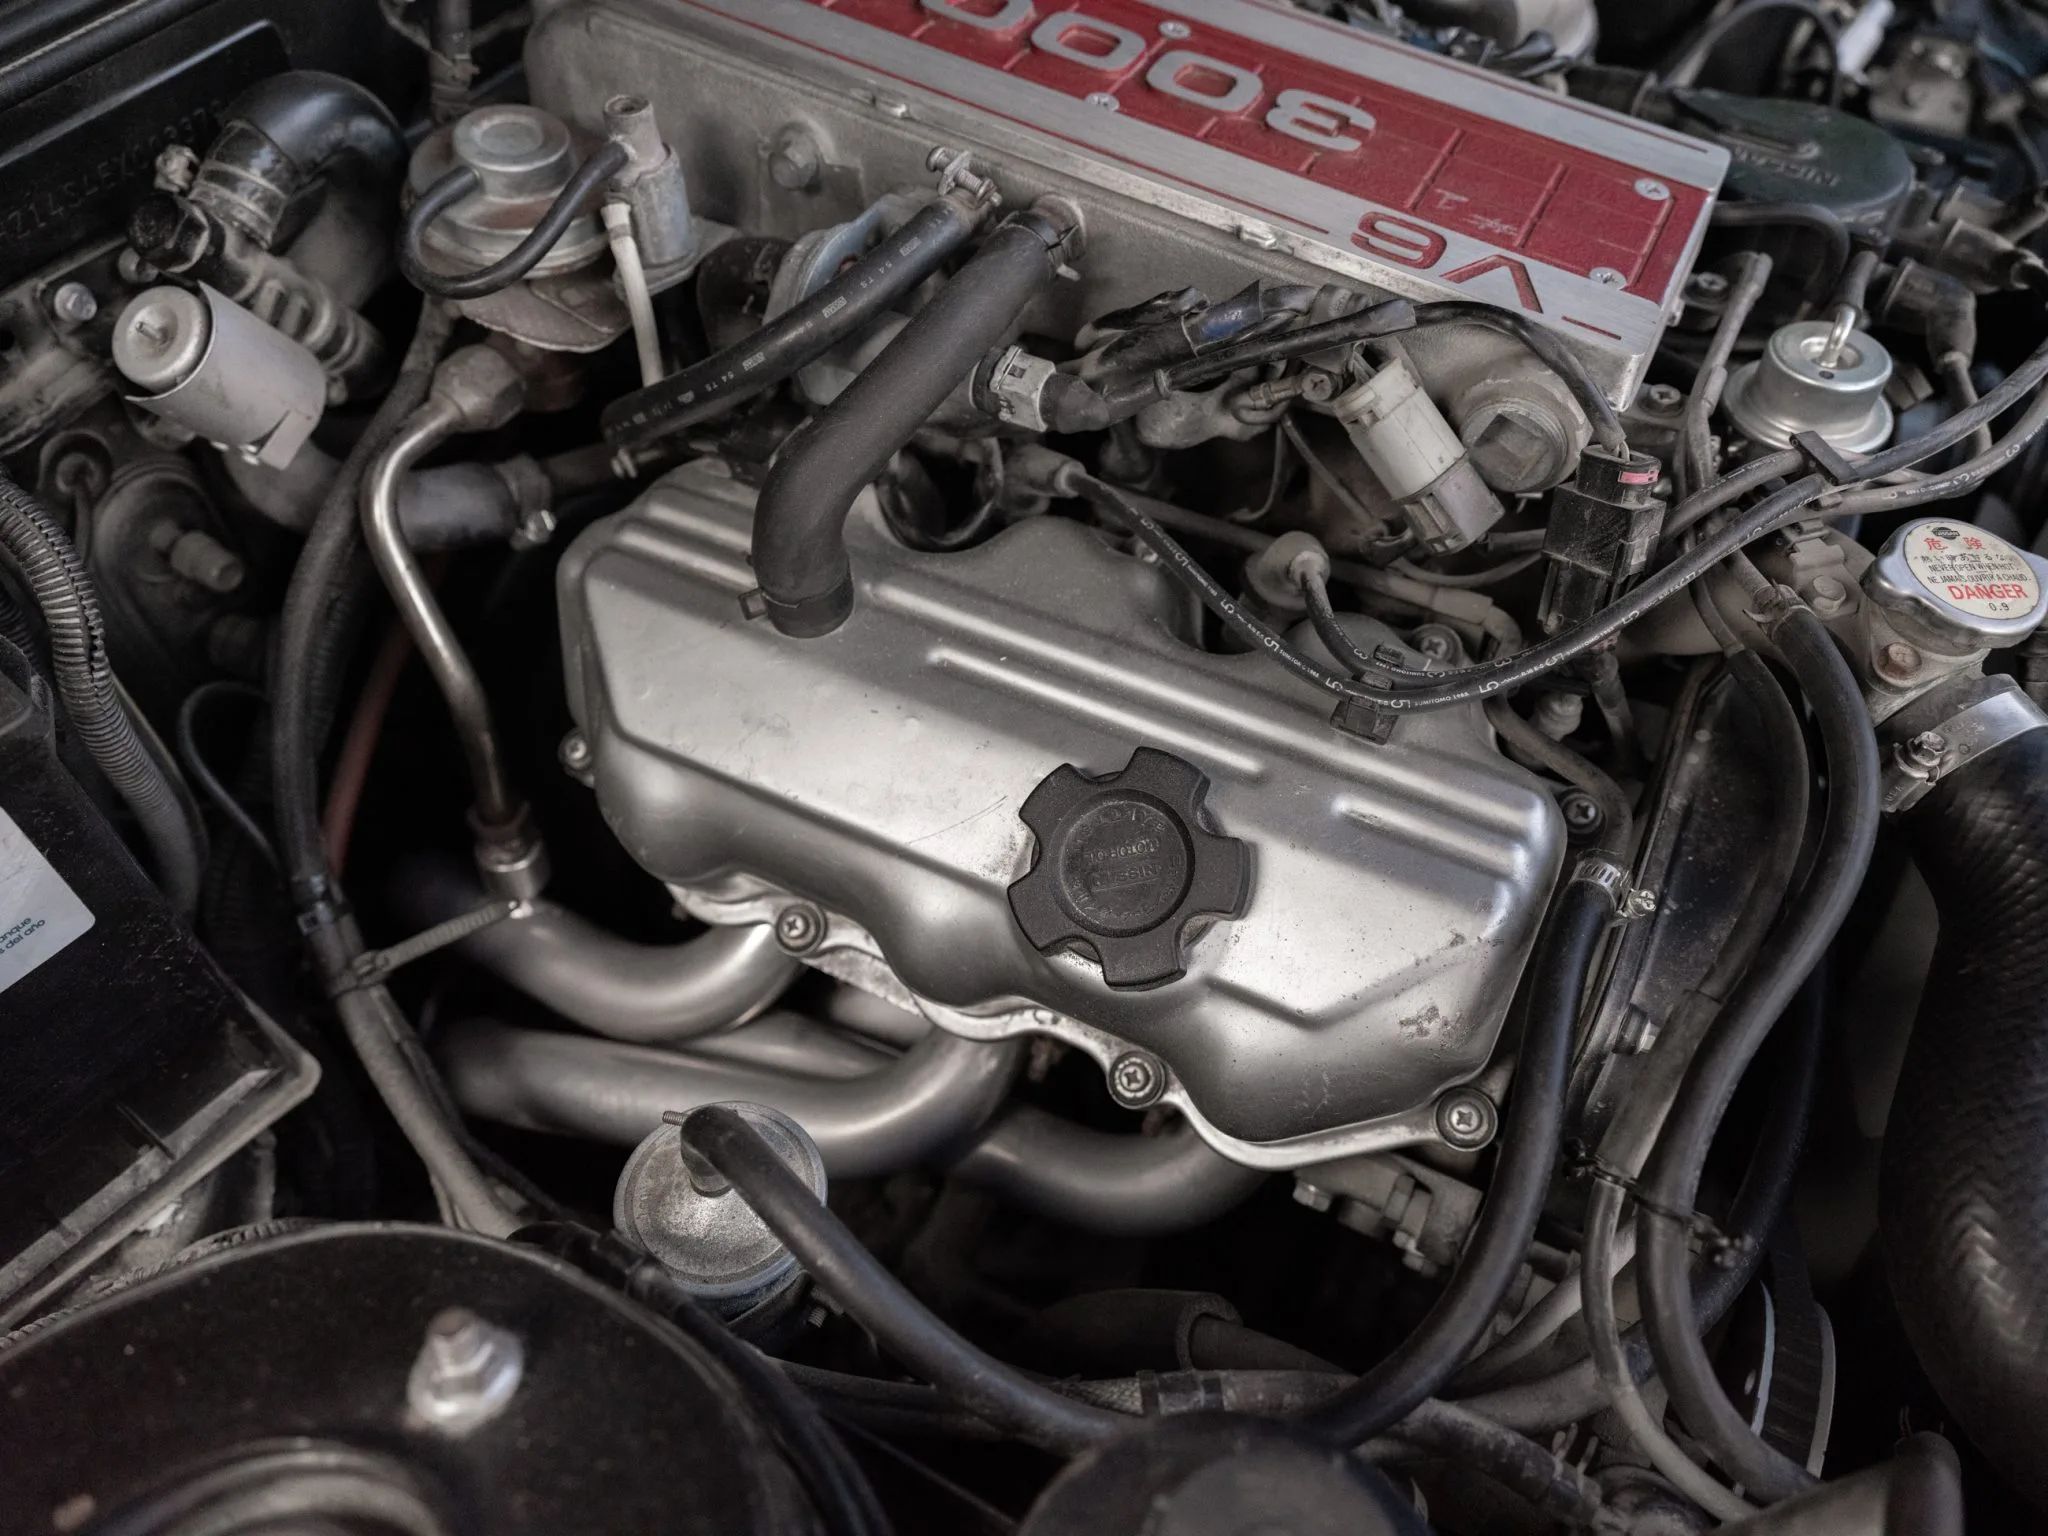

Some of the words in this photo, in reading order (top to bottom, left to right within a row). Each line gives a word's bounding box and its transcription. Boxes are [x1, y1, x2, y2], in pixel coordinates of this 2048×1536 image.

[1351, 211, 1544, 314] V6
[1928, 564, 1954, 573] NEVER
[1954, 563, 1977, 572] OPEN
[1977, 562, 1999, 571] WHEN
[1927, 575, 1941, 584] NE
[1947, 583, 2029, 600] DANGER
[1988, 602, 2010, 612] 0.9
[5, 934, 24, 949] del
